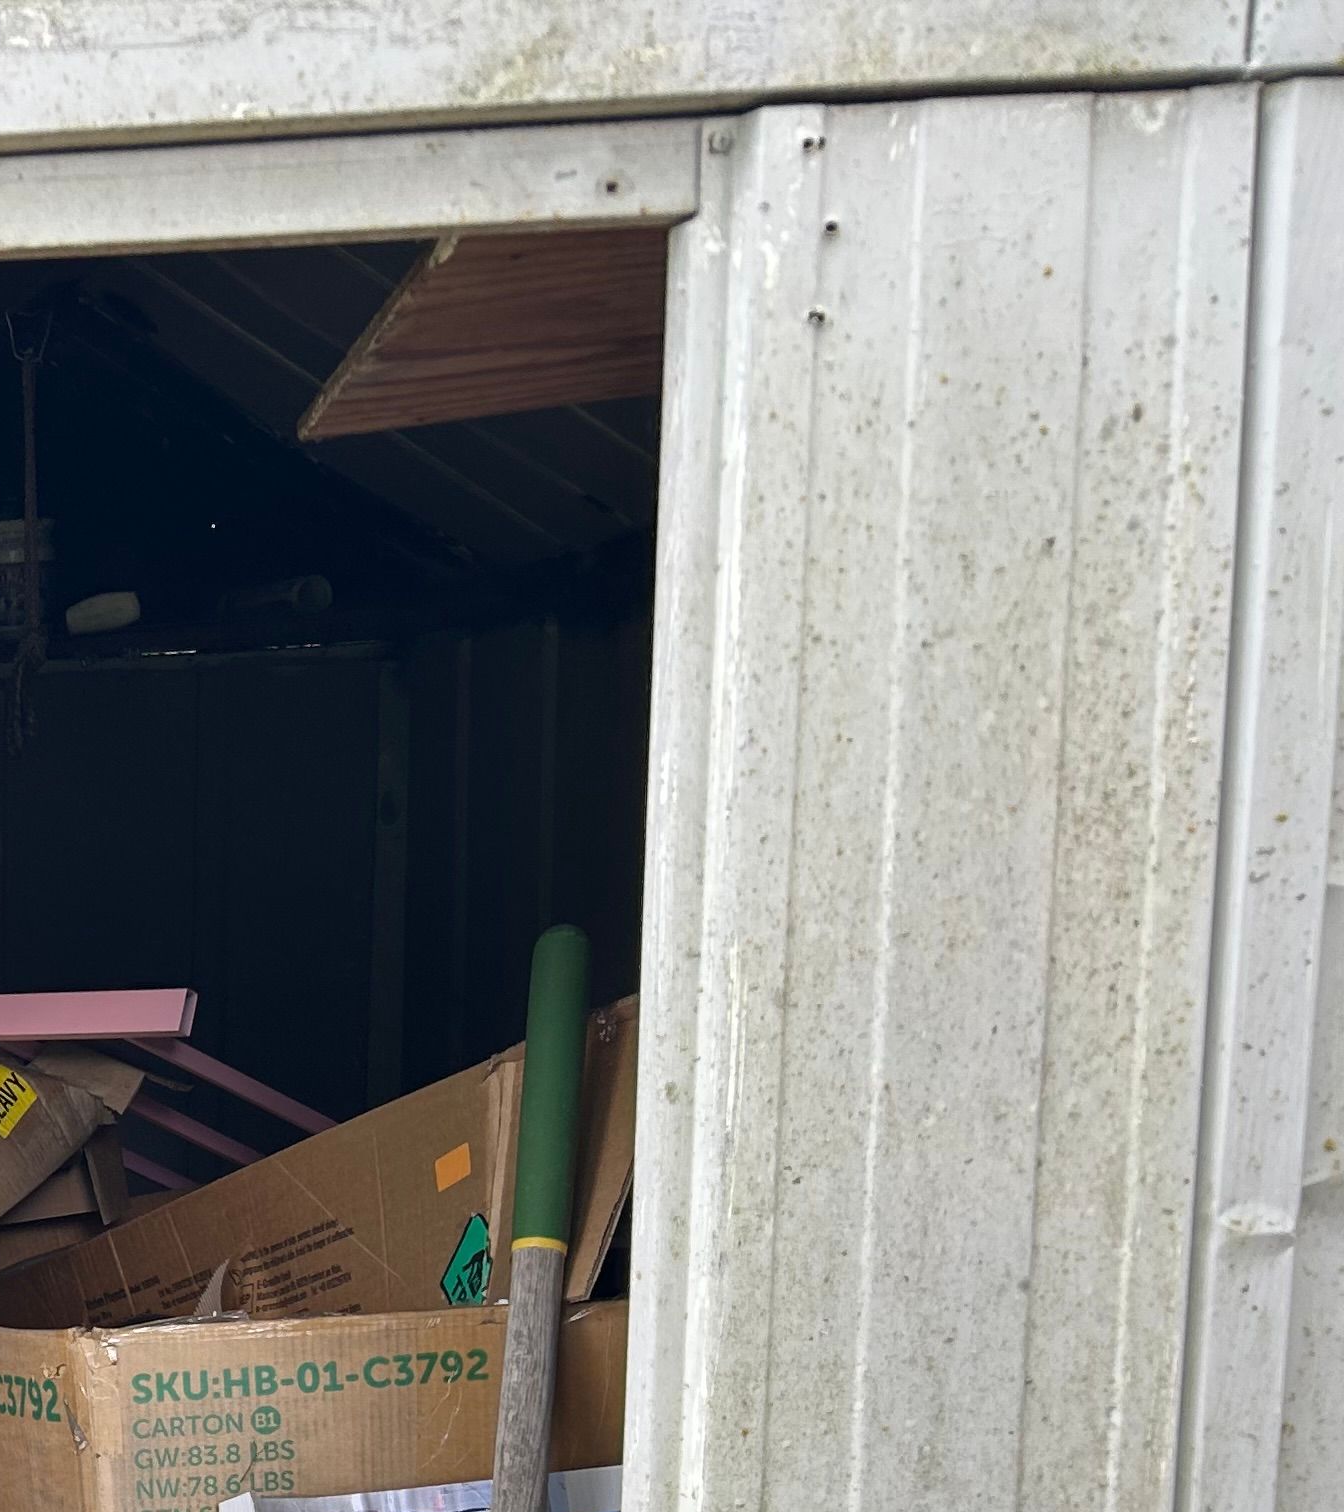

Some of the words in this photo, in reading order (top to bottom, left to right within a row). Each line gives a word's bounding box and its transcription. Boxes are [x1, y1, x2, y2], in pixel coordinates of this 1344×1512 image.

[130, 1348, 490, 1405] SKU:HB-01-C3792
[132, 1412, 244, 1439] CARTON
[134, 1443, 242, 1470] GW:83.8
[249, 1439, 295, 1464] LBS
[136, 1473, 241, 1500] NW:78.6
[249, 1470, 295, 1493] LBS
